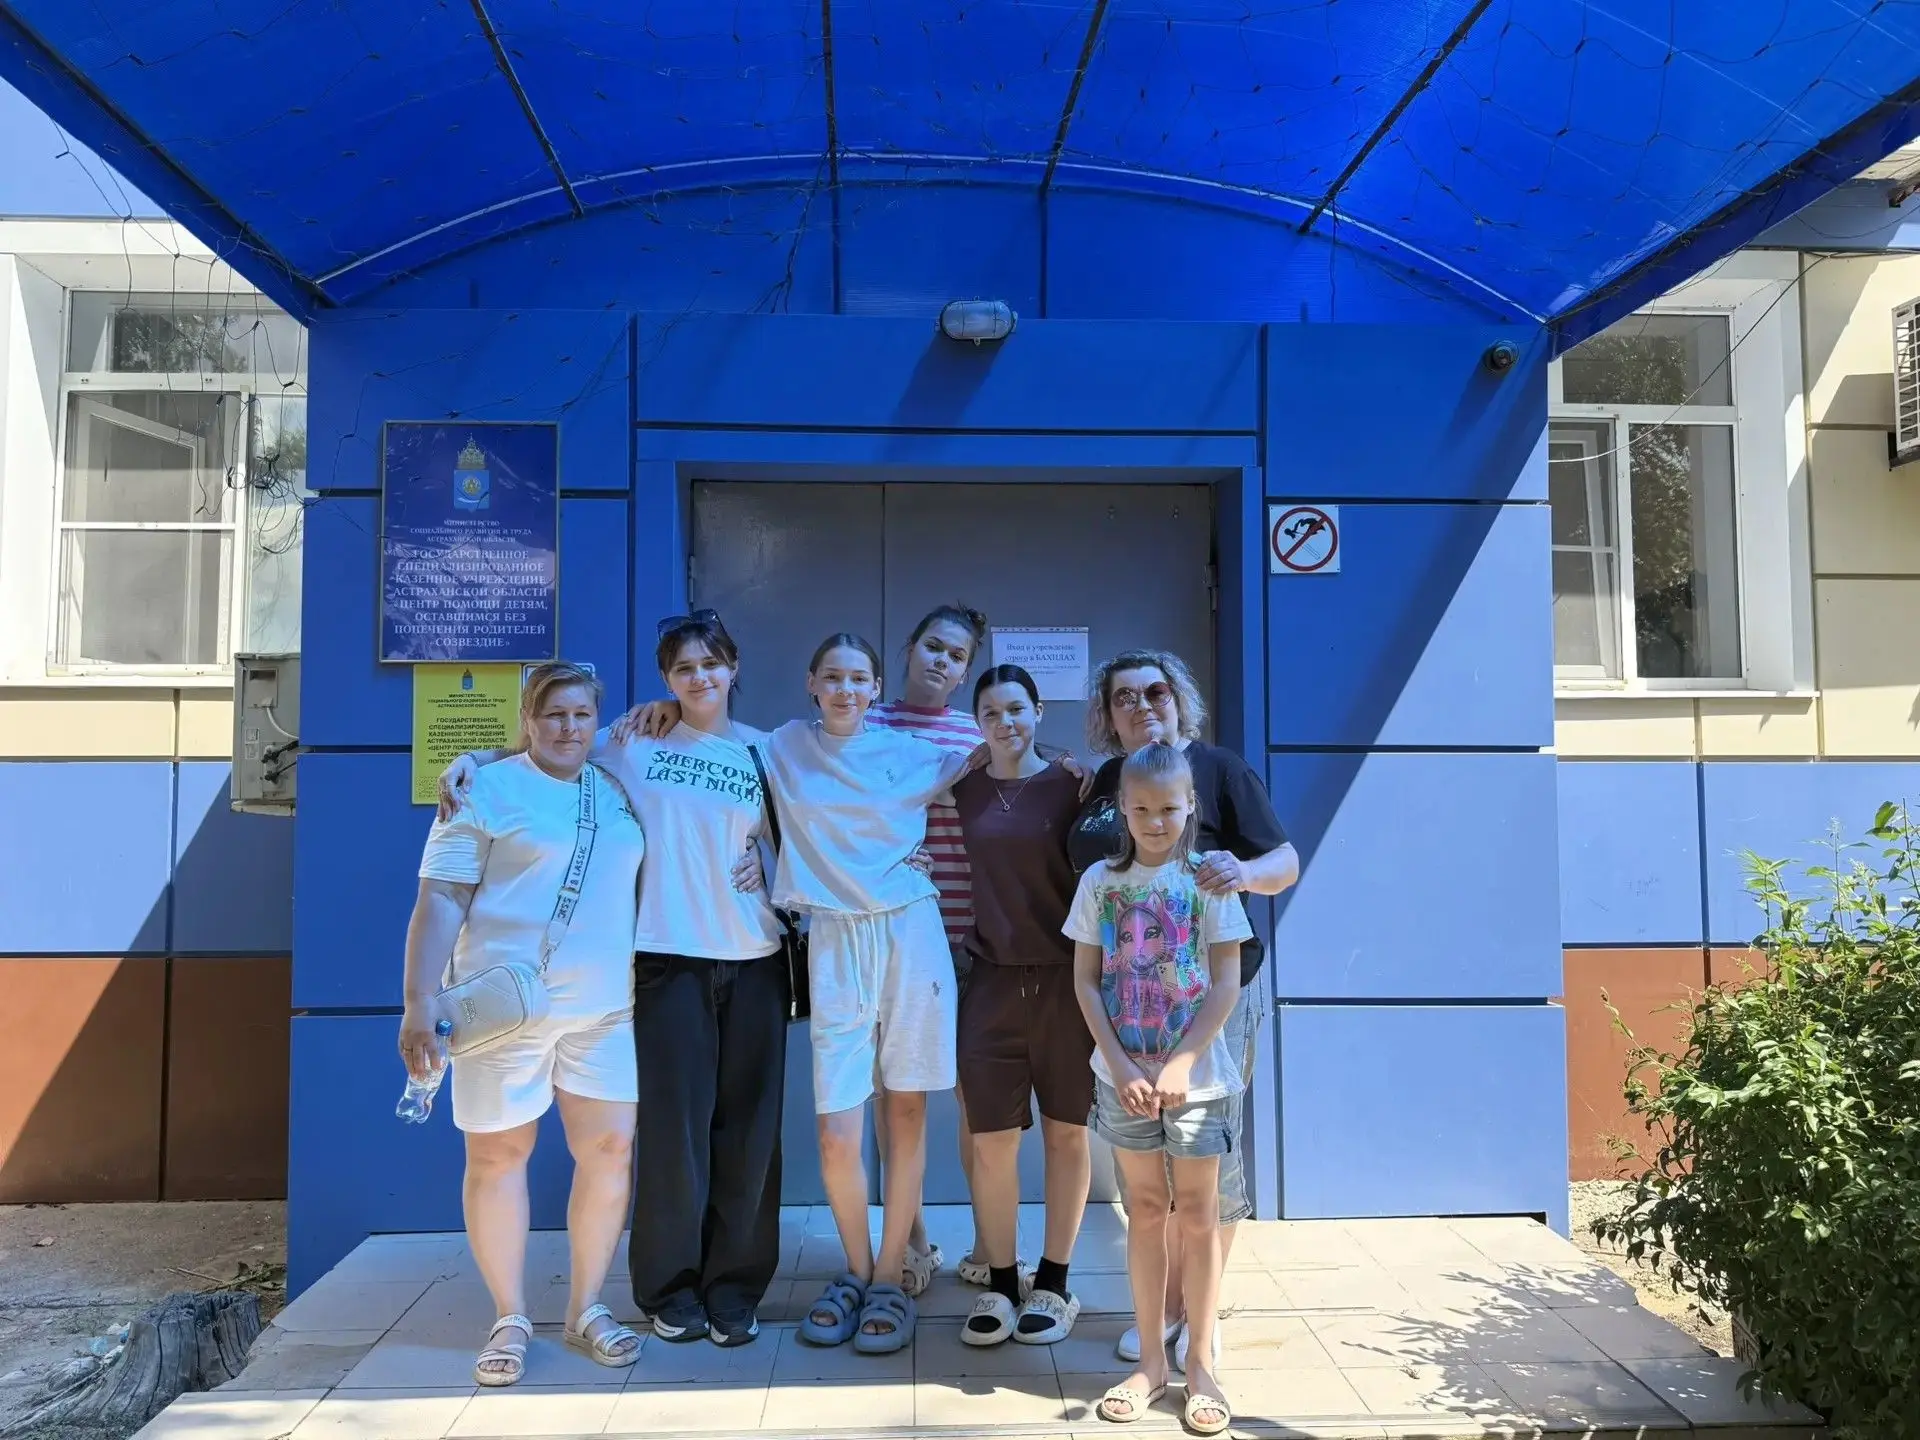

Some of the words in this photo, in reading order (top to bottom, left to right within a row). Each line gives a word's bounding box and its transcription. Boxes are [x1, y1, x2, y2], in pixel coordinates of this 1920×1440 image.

[464, 527, 501, 536] РАЗВИТИЯ
[510, 528, 532, 536] ТРУДА
[413, 550, 529, 560] ГОСУДАРСТВЕННОЕ
[397, 562, 545, 573] СПЕЦИАЛИЗИРОВАННОЕ
[395, 574, 459, 584] КАЗЕННОЕ
[462, 575, 546, 585] УЧРЕЖДЕНИЕ
[394, 586, 488, 598] АСТРАХАНСКОЙ
[492, 587, 548, 598] ОБЛАСТИ
[443, 599, 500, 611] ПОМОЩИ
[504, 600, 549, 611] ДЕТЯМ,
[415, 612, 500, 622] ОСТАВШИМСЯ
[504, 612, 527, 622] БЕЗ
[394, 624, 470, 635] ПОПЕЧЕНИЯ
[473, 623, 546, 636] РОДИТЕЛЕЙ
[430, 638, 510, 647] «СОЗВЕЗДИЕ»
[645, 767, 701, 786] LAST
